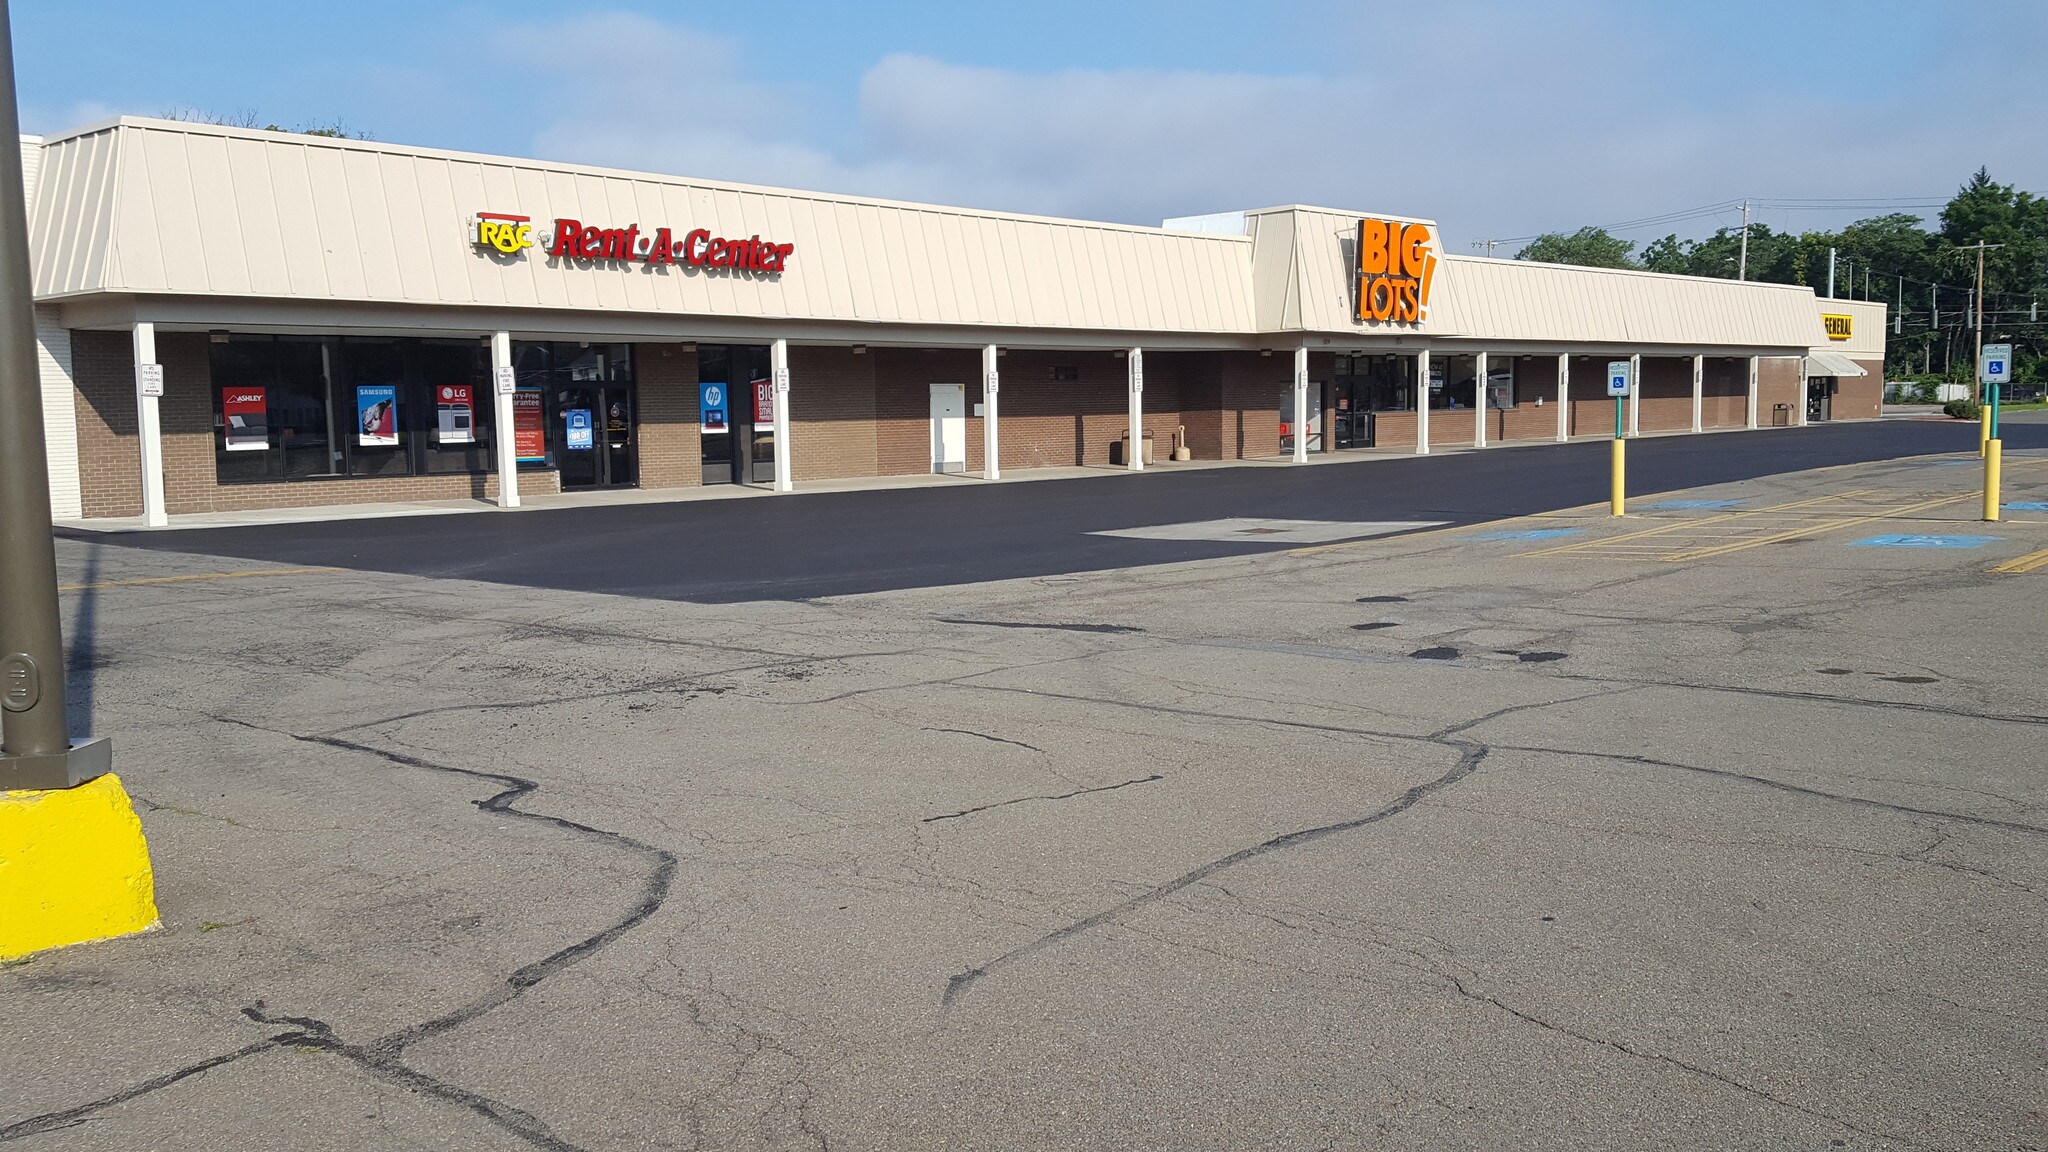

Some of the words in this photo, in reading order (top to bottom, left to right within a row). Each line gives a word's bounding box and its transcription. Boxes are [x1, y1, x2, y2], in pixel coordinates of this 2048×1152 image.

[479, 221, 532, 253] RAC
[1359, 218, 1432, 278] BIG
[1360, 251, 1437, 323] LOTS!
[236, 394, 262, 402] ASHLEY
[359, 388, 393, 396] SAMSUNG
[454, 389, 466, 398] LG
[757, 384, 773, 401] BIG
